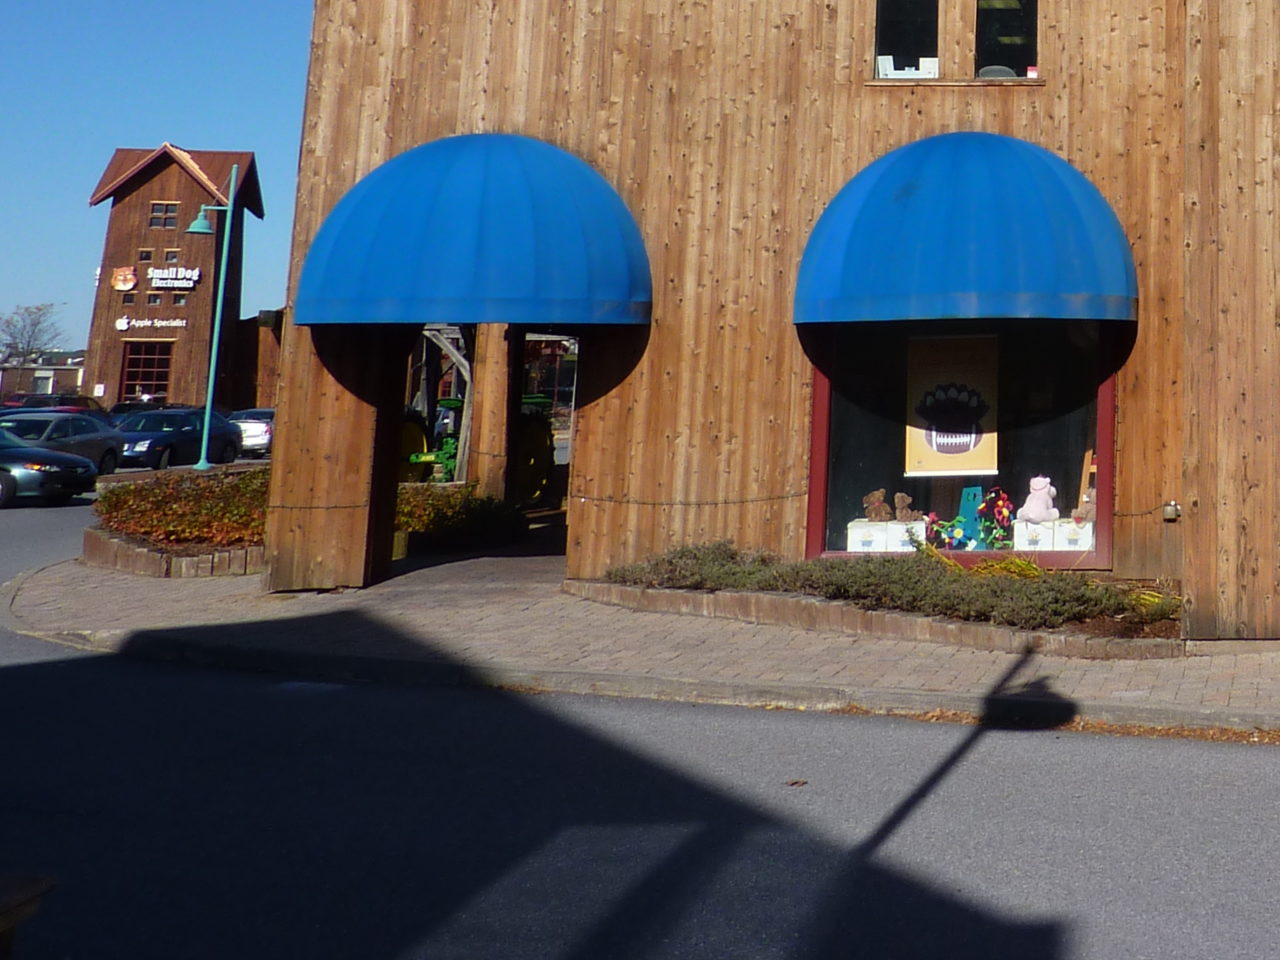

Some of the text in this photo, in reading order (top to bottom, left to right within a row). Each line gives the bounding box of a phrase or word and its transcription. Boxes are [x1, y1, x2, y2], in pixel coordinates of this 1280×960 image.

[147, 267, 200, 281] Small Dog
[151, 279, 194, 287] Electronics
[130, 318, 187, 328] Apple Specialist
